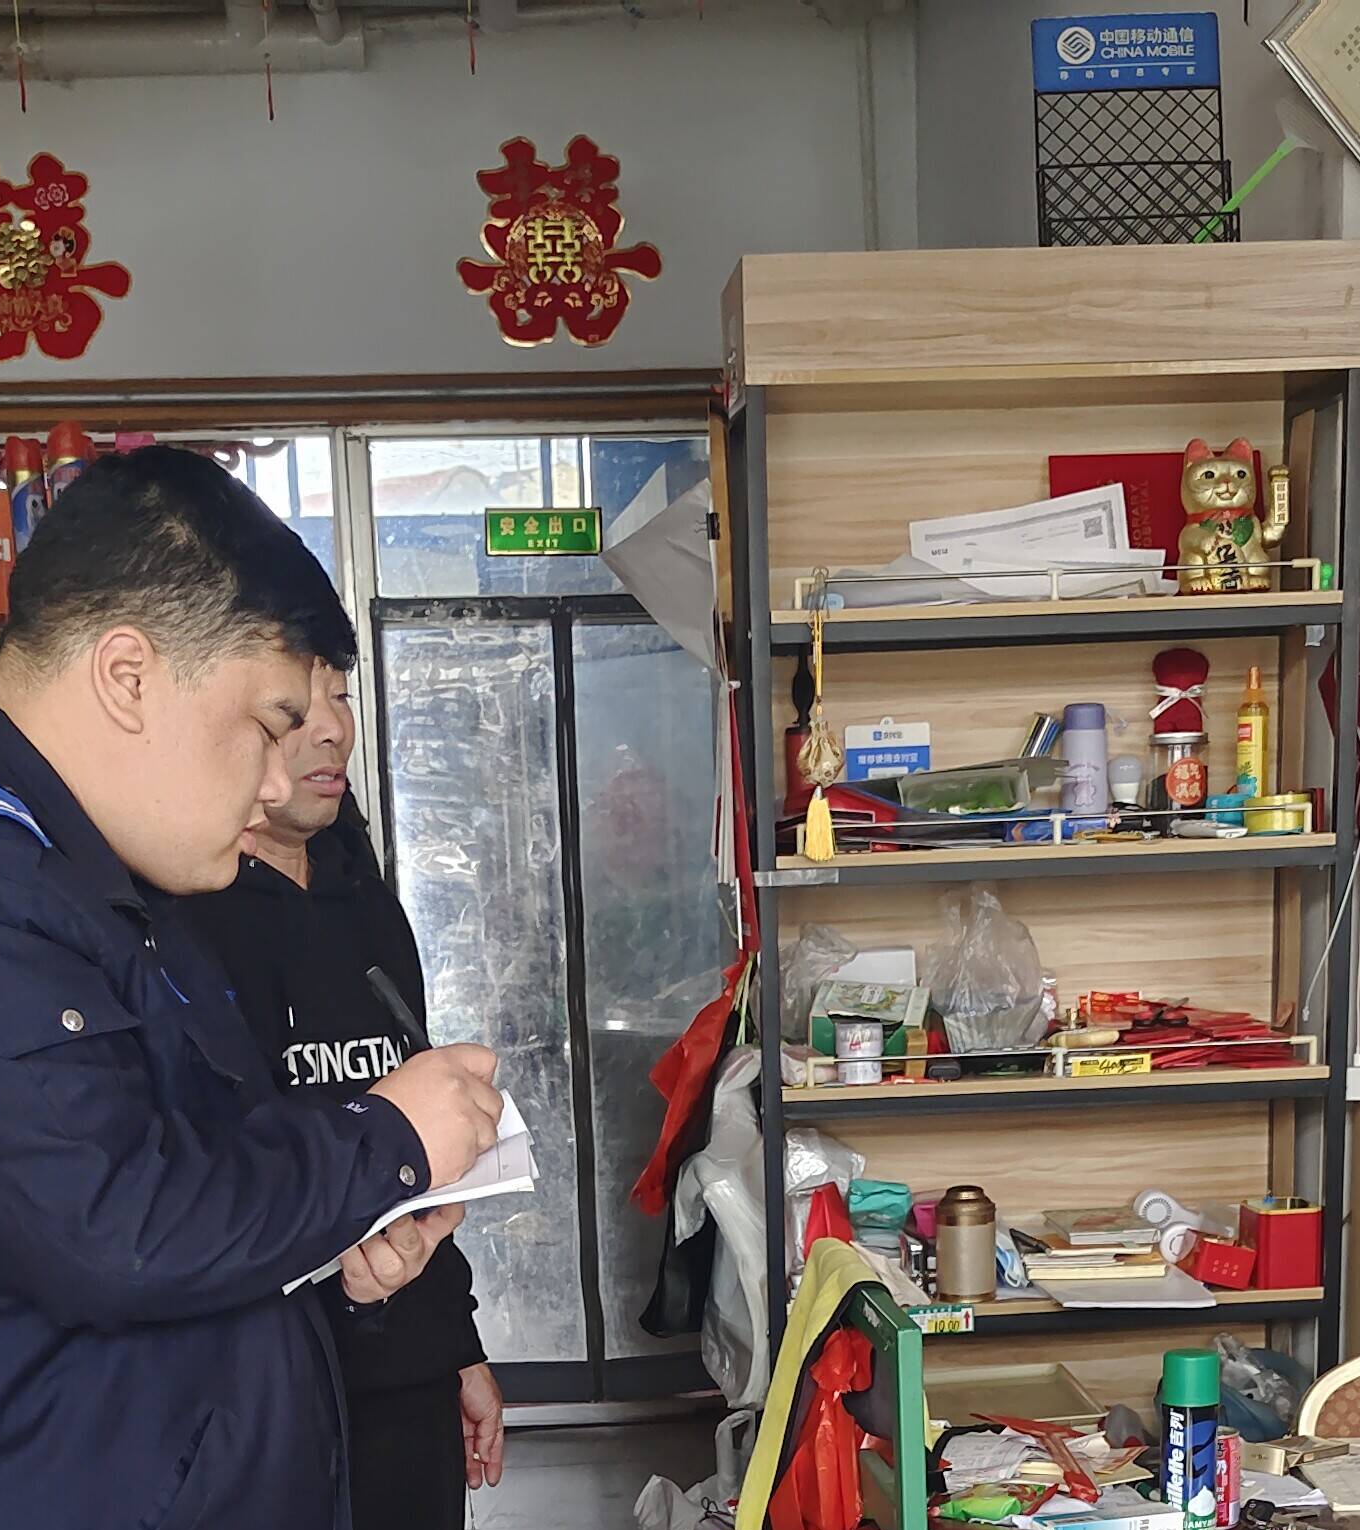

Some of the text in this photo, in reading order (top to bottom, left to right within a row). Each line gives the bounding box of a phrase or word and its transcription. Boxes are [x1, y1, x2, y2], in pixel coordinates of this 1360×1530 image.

[1099, 27, 1195, 45] 中国移动通信
[1101, 44, 1195, 59] CHINA MOBILE
[498, 514, 589, 535] 安全出口
[527, 537, 560, 549] EXIT
